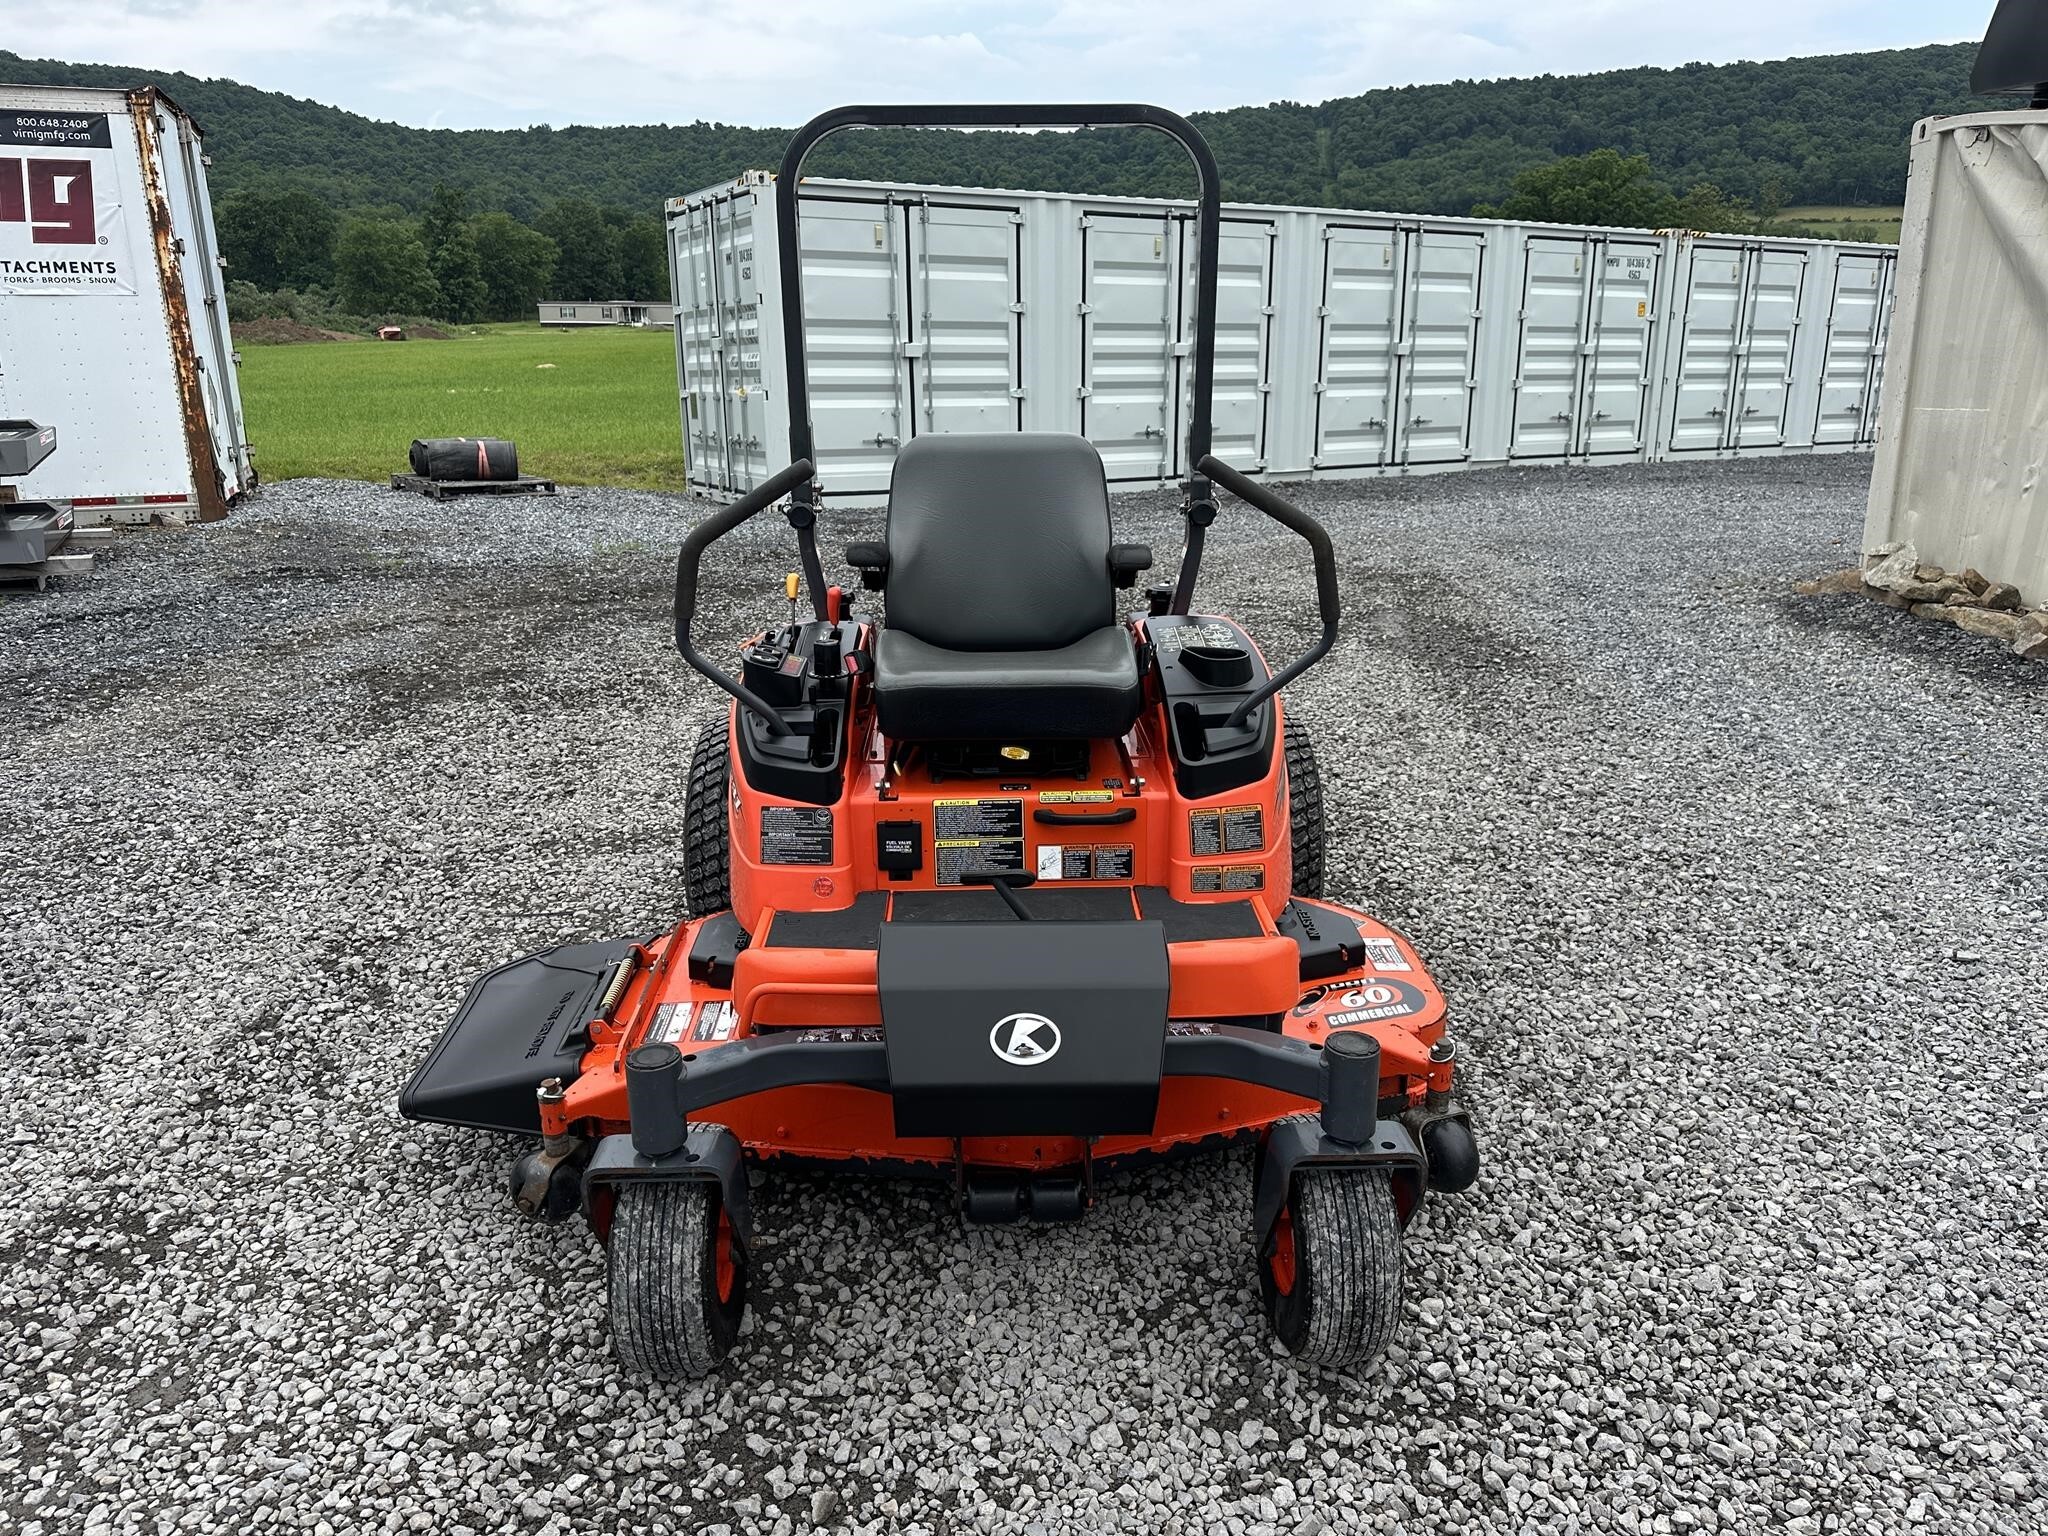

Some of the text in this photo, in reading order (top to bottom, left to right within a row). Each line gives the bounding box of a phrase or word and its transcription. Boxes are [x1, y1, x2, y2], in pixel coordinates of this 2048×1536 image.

[16, 117, 89, 129] 800.648.2408
[12, 129, 91, 142] virnigmfg.com
[4, 276, 35, 284] FORKS
[42, 276, 82, 284] BROOMS
[1340, 986, 1392, 1008] 60
[1328, 1003, 1413, 1025] COMMERCIAL
